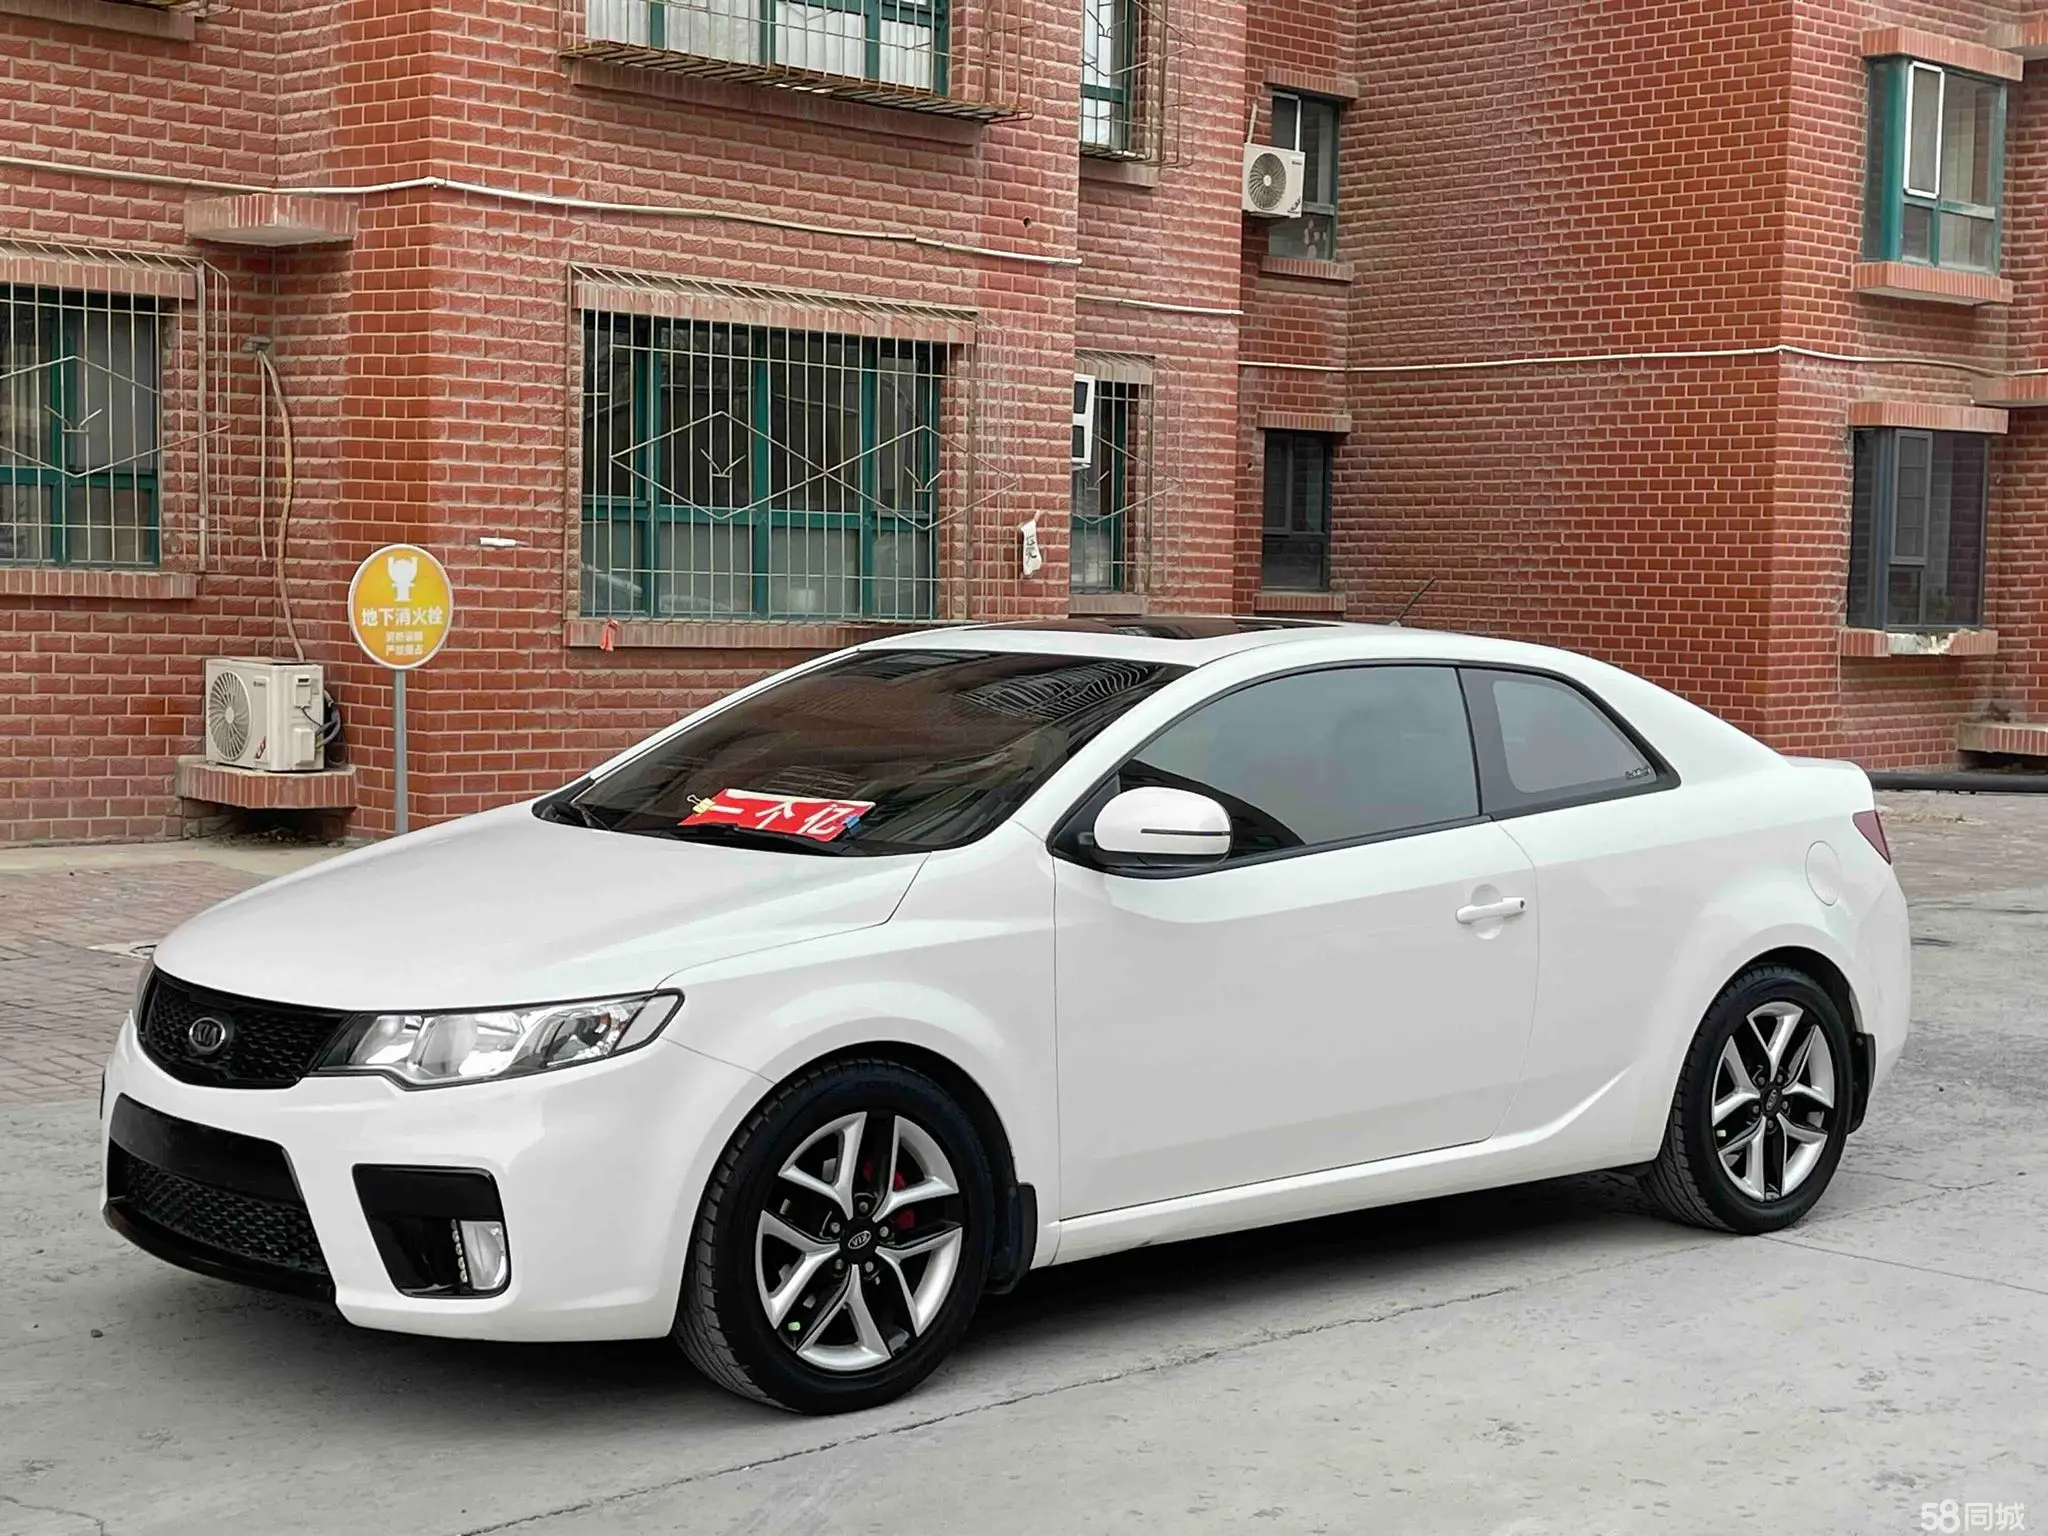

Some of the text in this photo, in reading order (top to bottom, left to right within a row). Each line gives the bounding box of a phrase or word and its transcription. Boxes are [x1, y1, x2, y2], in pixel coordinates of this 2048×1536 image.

[361, 605, 443, 627] 地下消火栓
[708, 799, 855, 835] 一个亿
